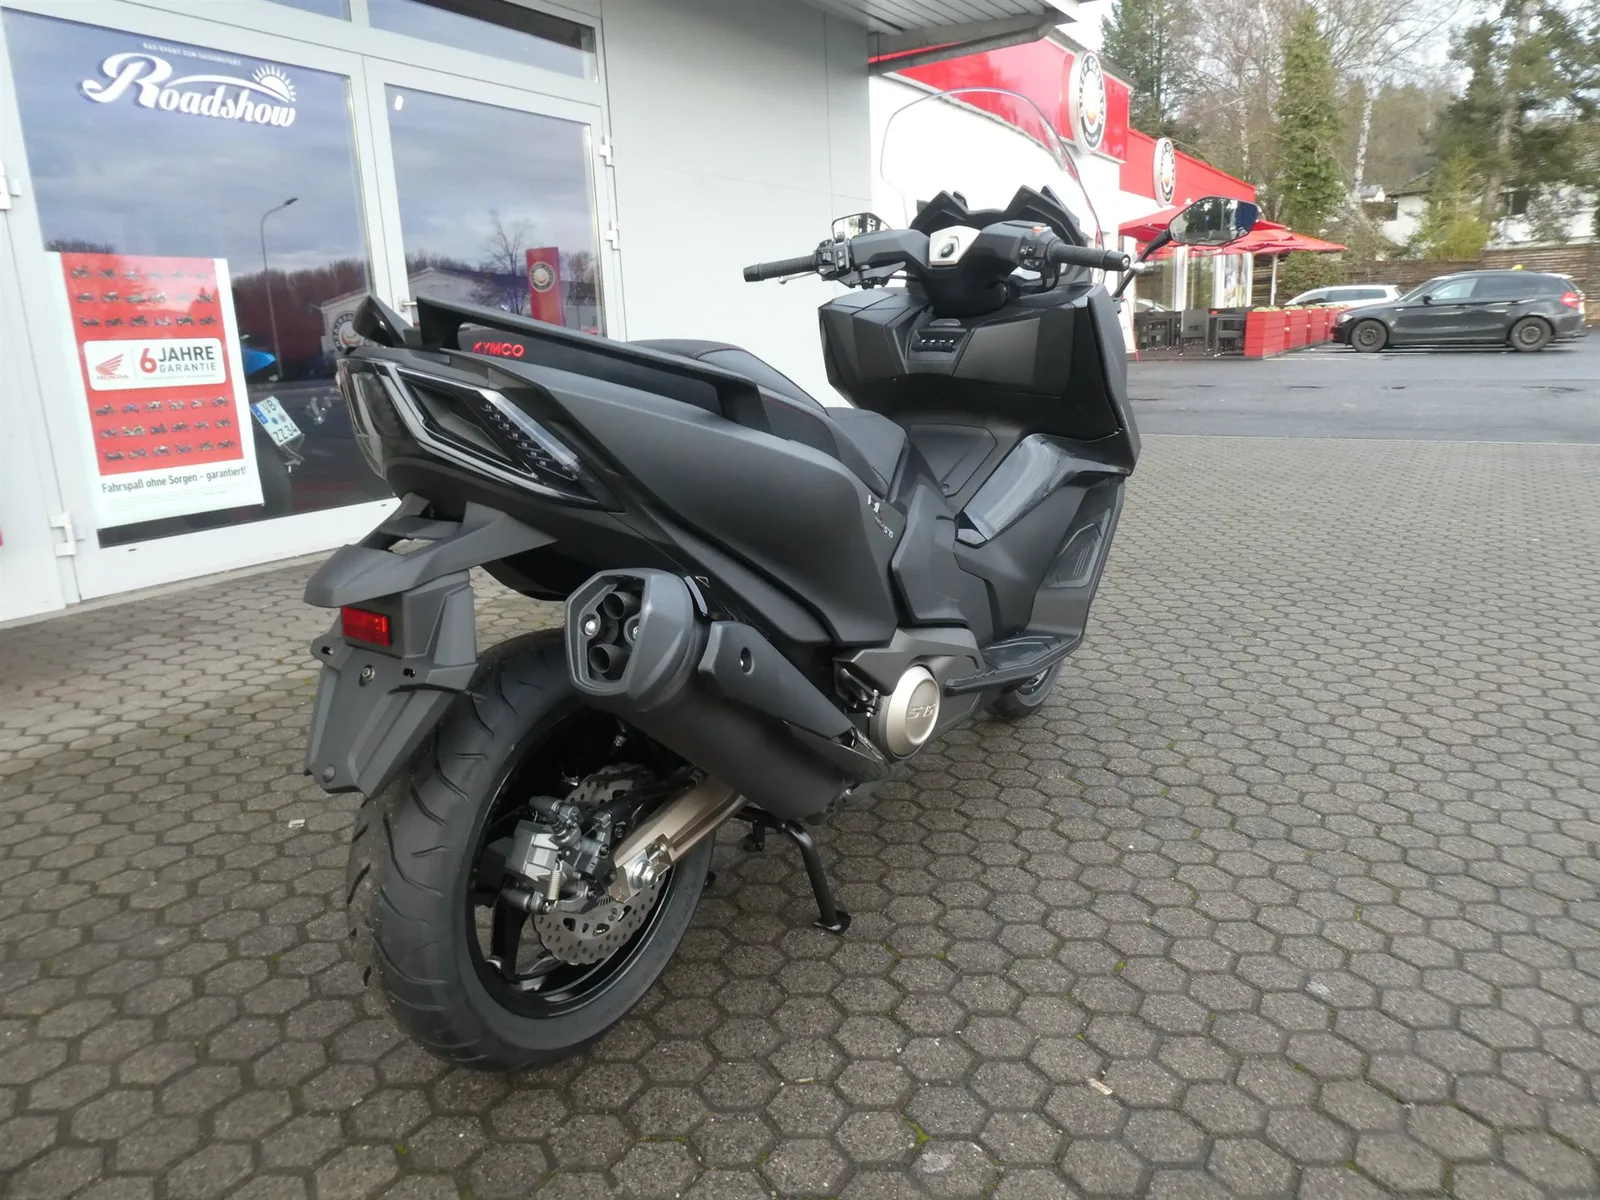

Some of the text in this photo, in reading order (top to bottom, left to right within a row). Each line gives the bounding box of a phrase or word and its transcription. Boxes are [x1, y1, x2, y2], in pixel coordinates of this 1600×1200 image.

[82, 52, 296, 127] Roadshow
[139, 346, 215, 373] 6 JAHRE
[473, 342, 525, 357] KYMCO
[159, 362, 216, 374] GARANTIE
[101, 478, 143, 494] Fahrspaß
[146, 478, 167, 489] ohne
[168, 473, 197, 486] Sorgen
[206, 465, 247, 482] garantiert!
